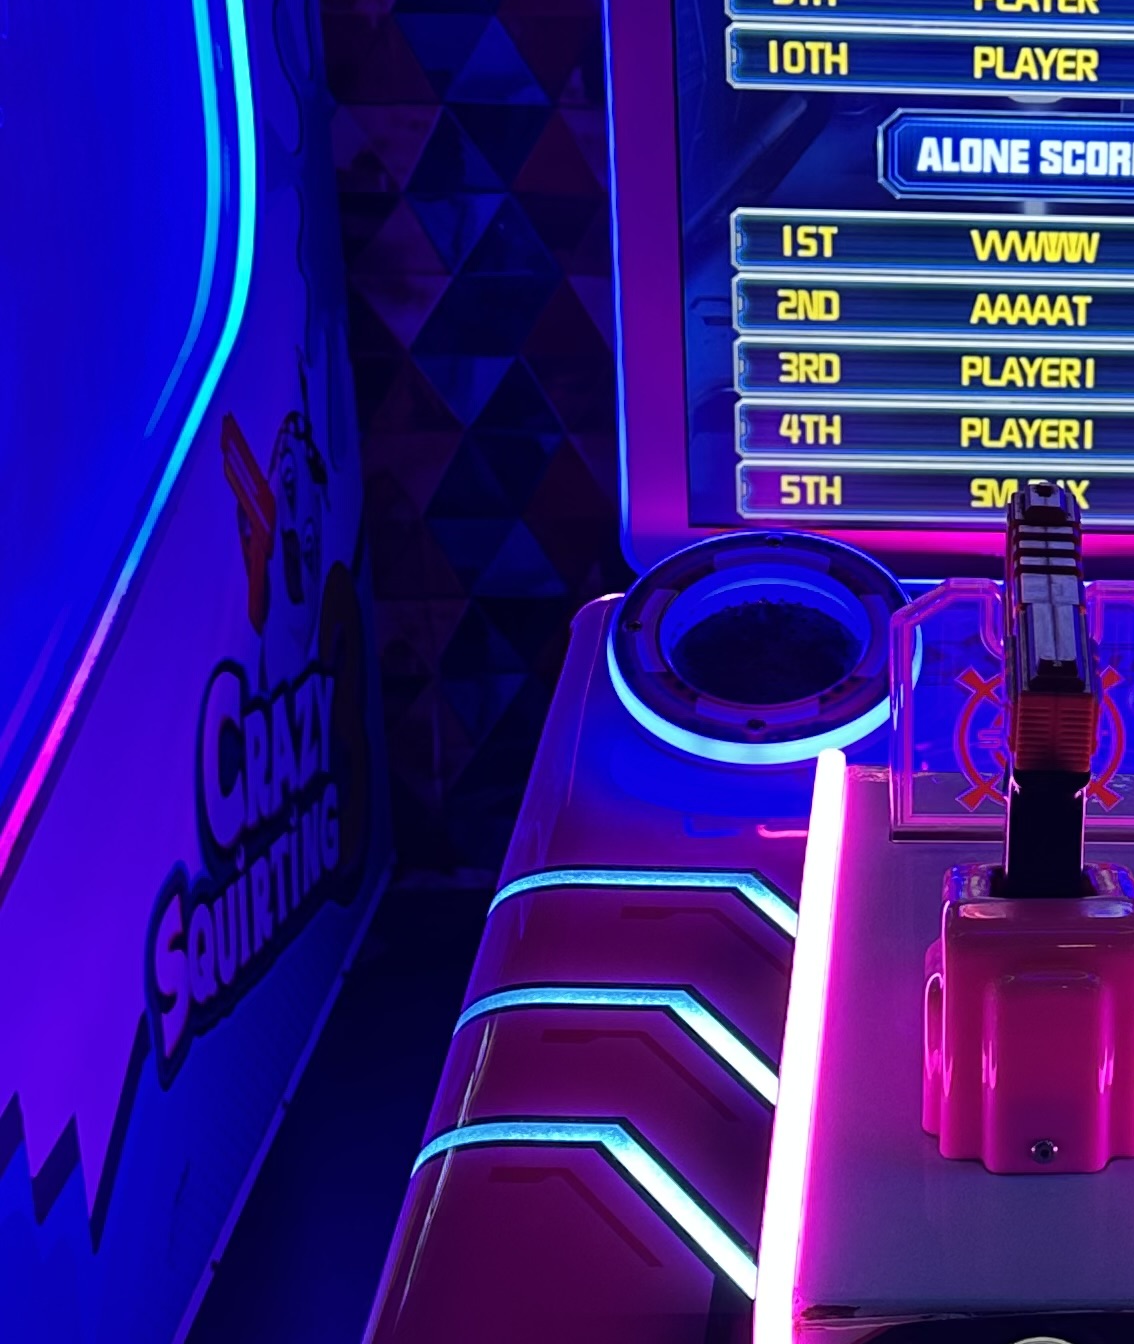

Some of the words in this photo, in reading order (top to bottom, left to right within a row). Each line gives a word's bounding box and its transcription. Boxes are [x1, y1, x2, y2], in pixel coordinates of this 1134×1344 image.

[768, 40, 848, 74] 10TH
[973, 46, 1099, 81] PLAYER
[917, 136, 1030, 176] ALONE
[782, 225, 837, 257] 1ST
[777, 289, 840, 321] 2ND
[970, 293, 1092, 326] AAAAAT
[778, 352, 841, 383] 3RD
[779, 414, 841, 445] 4TH
[780, 475, 842, 505] 5TH
[203, 668, 336, 847] CRAZY
